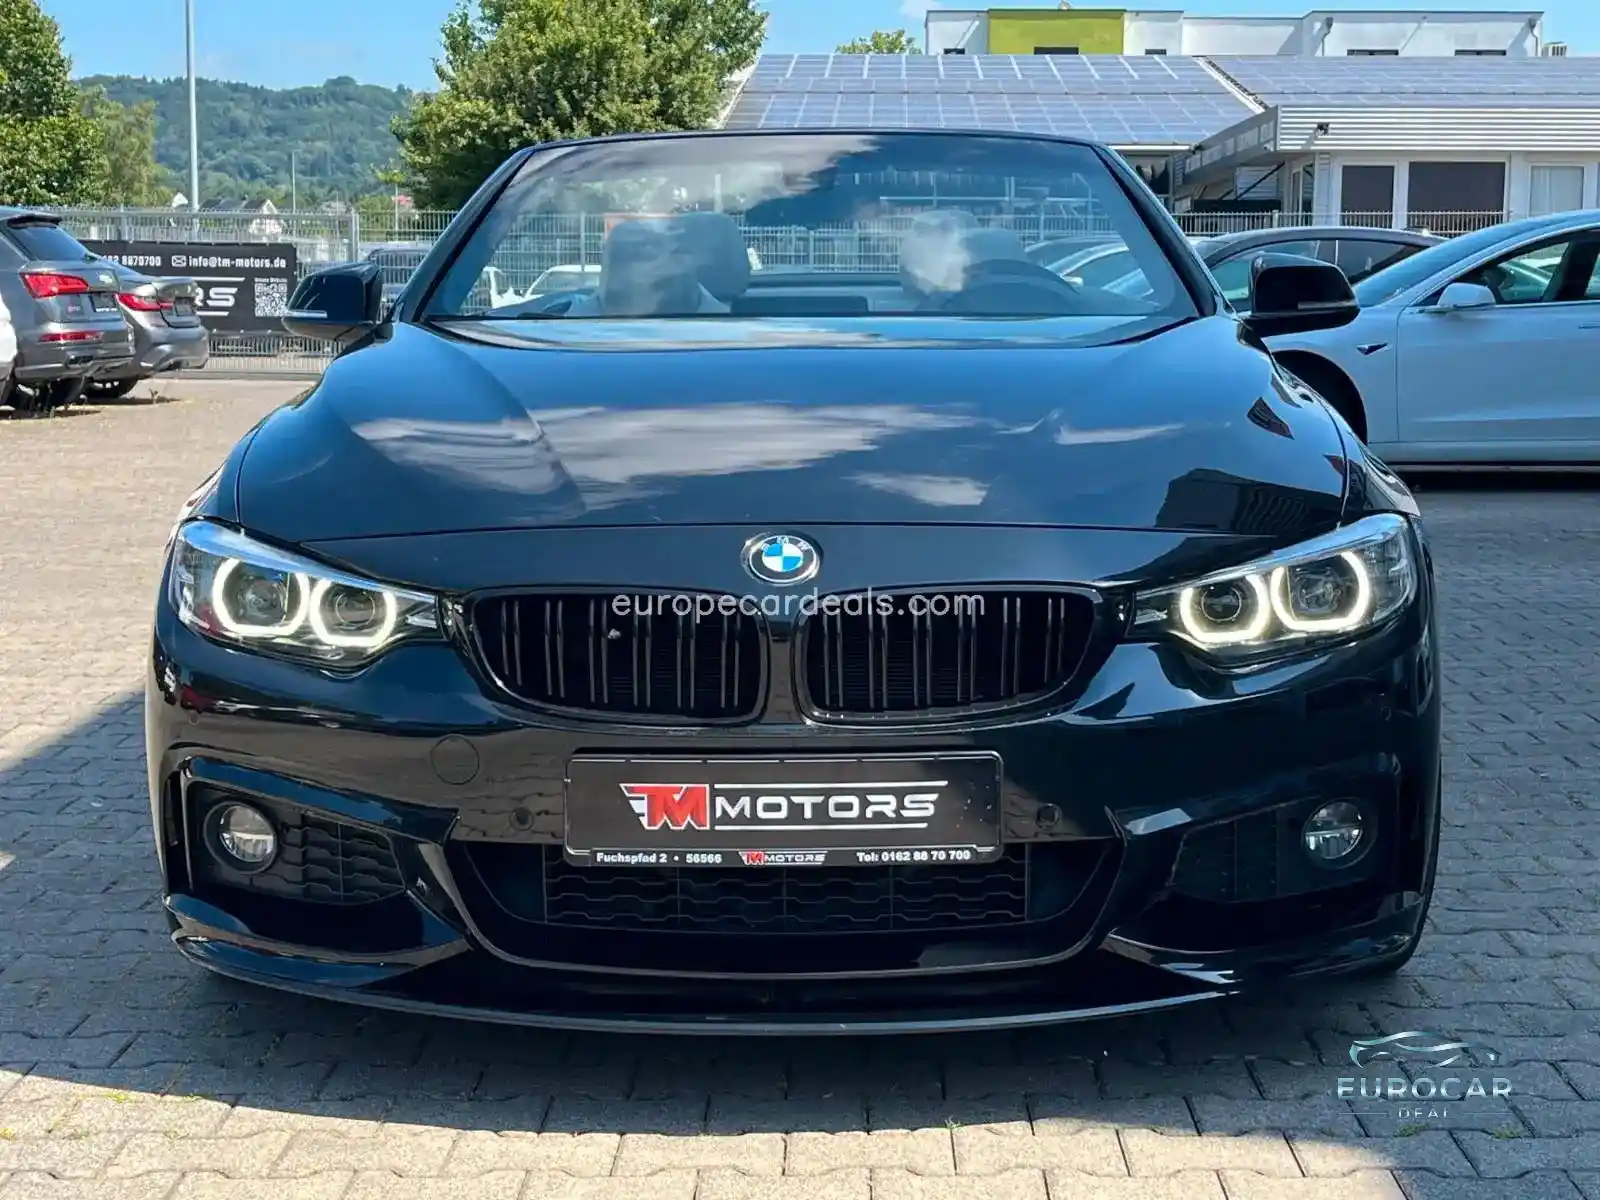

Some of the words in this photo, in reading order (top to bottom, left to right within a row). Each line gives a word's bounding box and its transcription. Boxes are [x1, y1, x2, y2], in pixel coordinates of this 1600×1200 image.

[715, 793, 939, 819] MOTORS
[596, 852, 657, 865] Fuchspfad
[659, 852, 668, 863] 2
[765, 853, 826, 863] MOTORS
[931, 850, 946, 861] 70
[949, 850, 971, 860] 700
